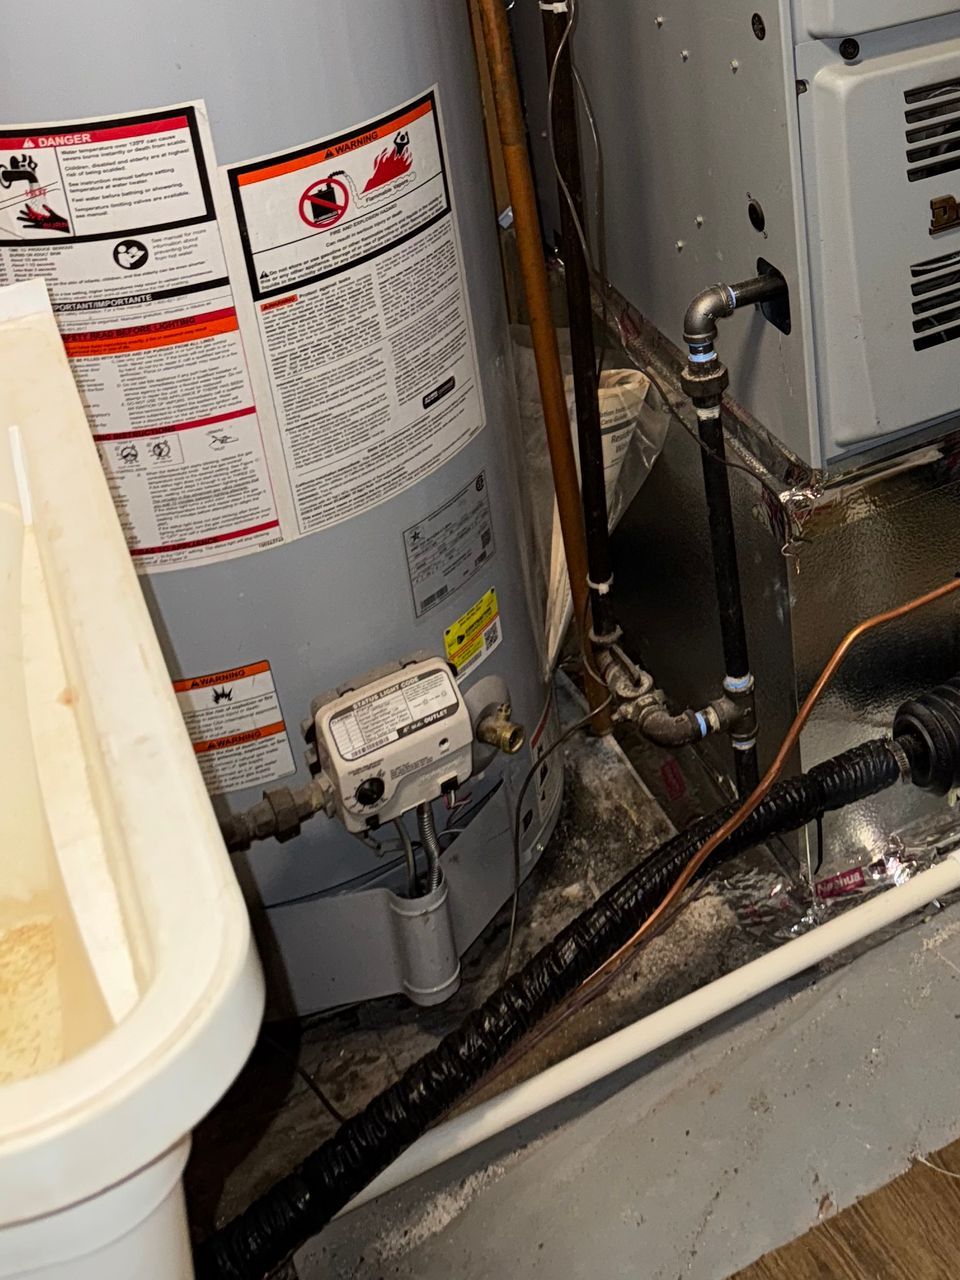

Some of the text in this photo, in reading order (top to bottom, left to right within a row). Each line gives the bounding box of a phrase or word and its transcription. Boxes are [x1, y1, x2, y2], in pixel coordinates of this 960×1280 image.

[38, 134, 91, 147] DANGER
[335, 131, 379, 155] WARNING
[121, 189, 144, 198] bathing
[365, 186, 393, 203] Flammable
[74, 204, 109, 213] Temperature
[110, 200, 132, 209] limiting
[330, 228, 342, 236] FIRE
[354, 212, 379, 227] EXPLOSION
[380, 203, 397, 214] HAZARD
[116, 323, 151, 338] BEFORE
[155, 317, 197, 333] LIGHTING
[200, 669, 245, 685] WARNING
[352, 677, 419, 709] STATUS LIGHT CODE
[424, 709, 448, 724] OUTLET
[218, 731, 262, 747] WARNING
[817, 874, 861, 894] Nashua
